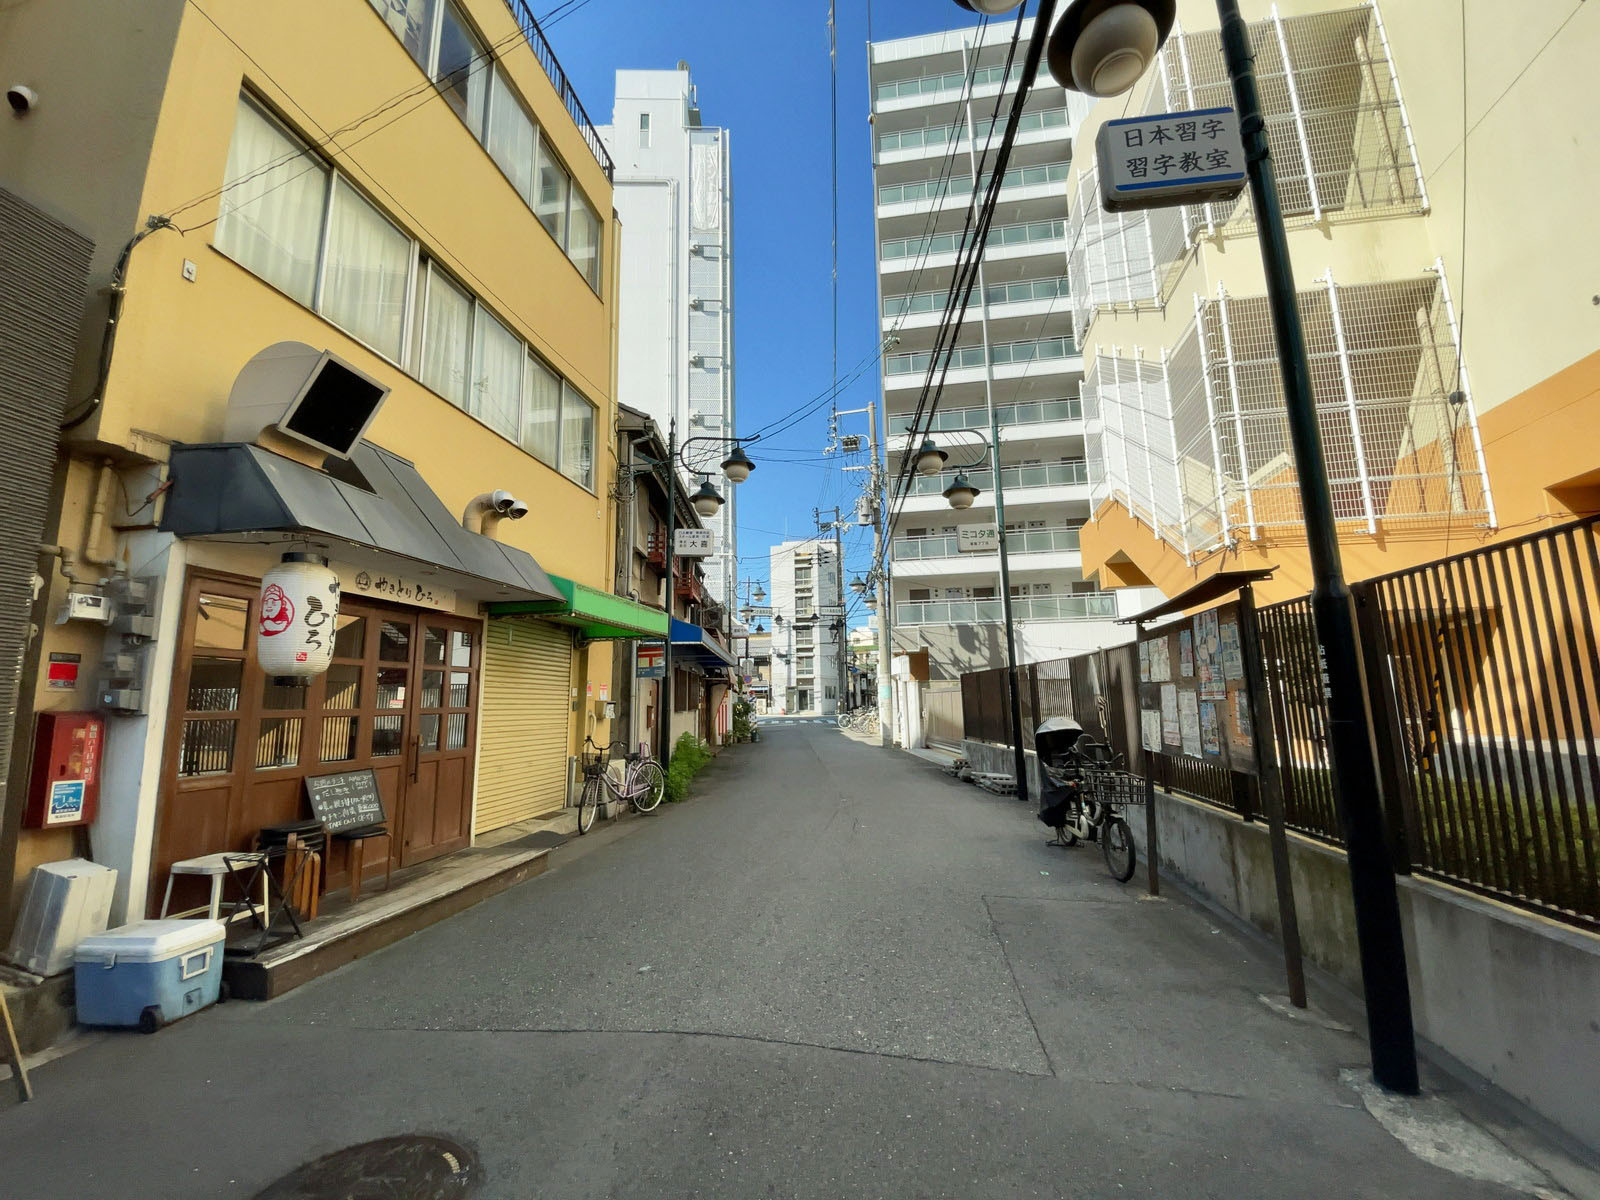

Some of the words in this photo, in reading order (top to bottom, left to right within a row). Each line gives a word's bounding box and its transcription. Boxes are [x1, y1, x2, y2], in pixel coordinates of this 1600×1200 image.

[1124, 119, 1226, 148] 日本習字
[1126, 148, 1232, 178] 習字教室
[961, 529, 995, 539] ミコタ通
[375, 577, 412, 599] やきとり
[414, 584, 433, 602] ひろ
[304, 595, 330, 652] ひろ
